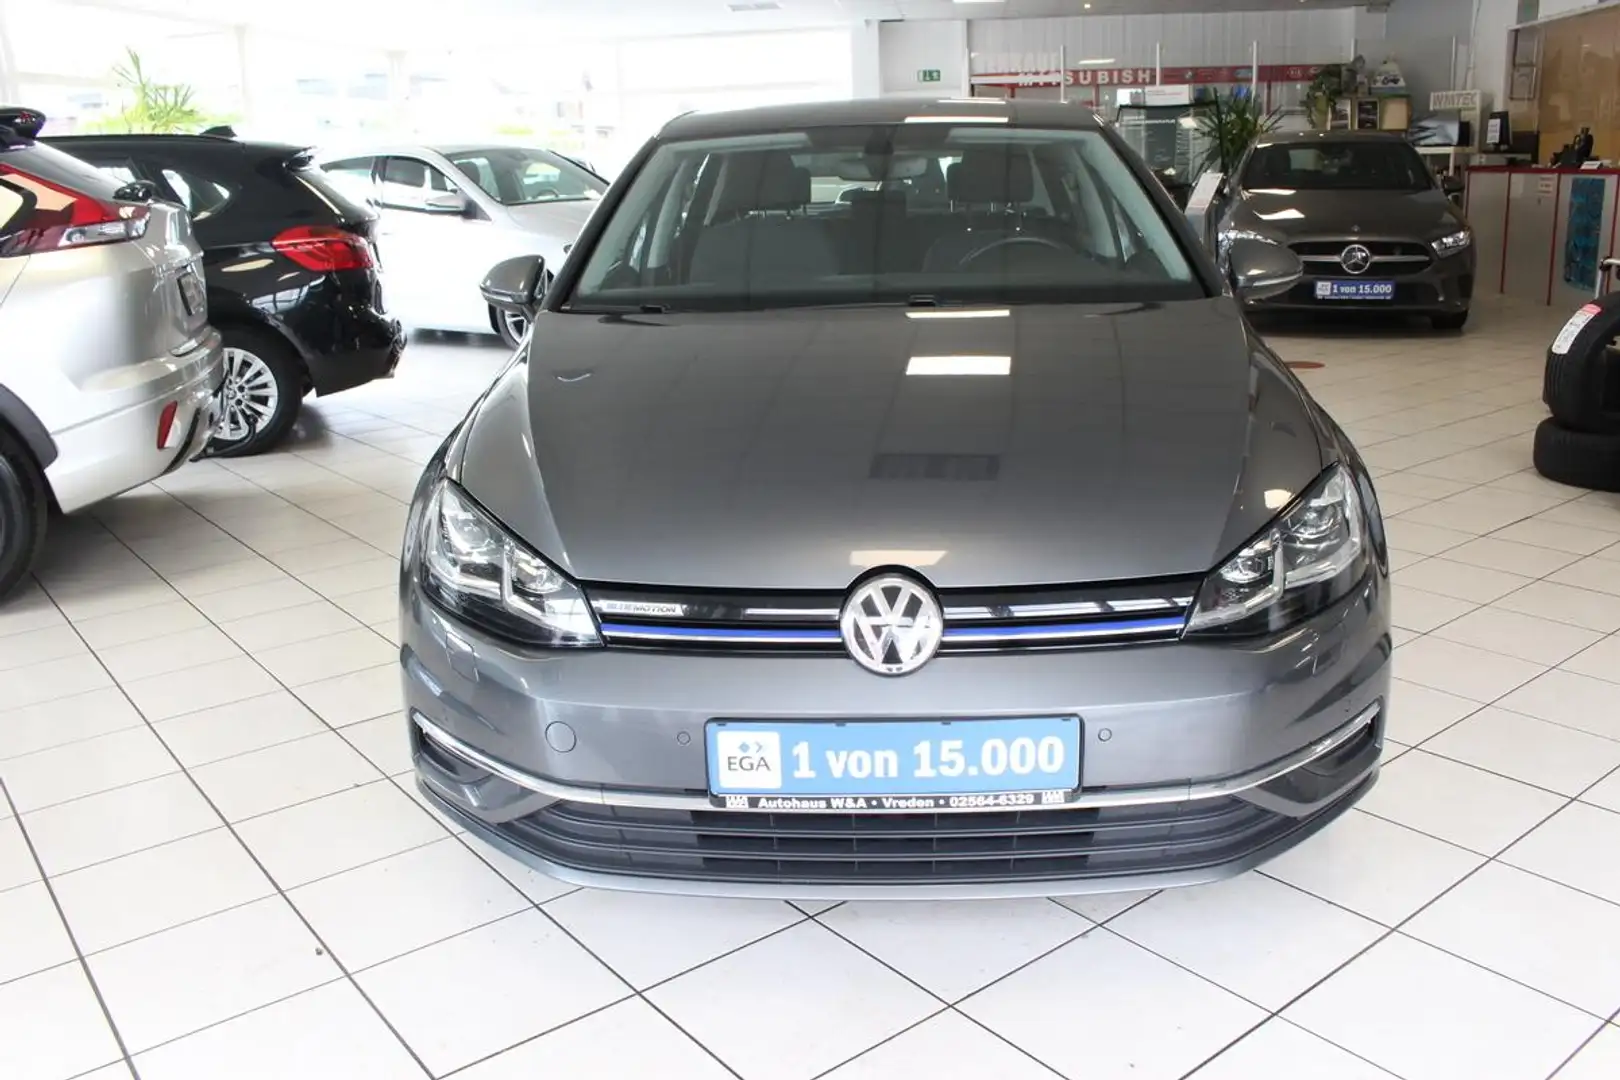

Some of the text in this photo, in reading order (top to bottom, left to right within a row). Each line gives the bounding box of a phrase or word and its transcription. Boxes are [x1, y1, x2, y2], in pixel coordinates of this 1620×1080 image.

[1359, 284, 1392, 293] 15.000
[727, 756, 771, 772] EGA
[791, 735, 1064, 779] 1 von 15.000
[757, 797, 827, 809] Autohaus
[830, 797, 868, 809] W&A
[882, 796, 935, 809] Vreden
[949, 793, 1035, 808] 02564-6329
